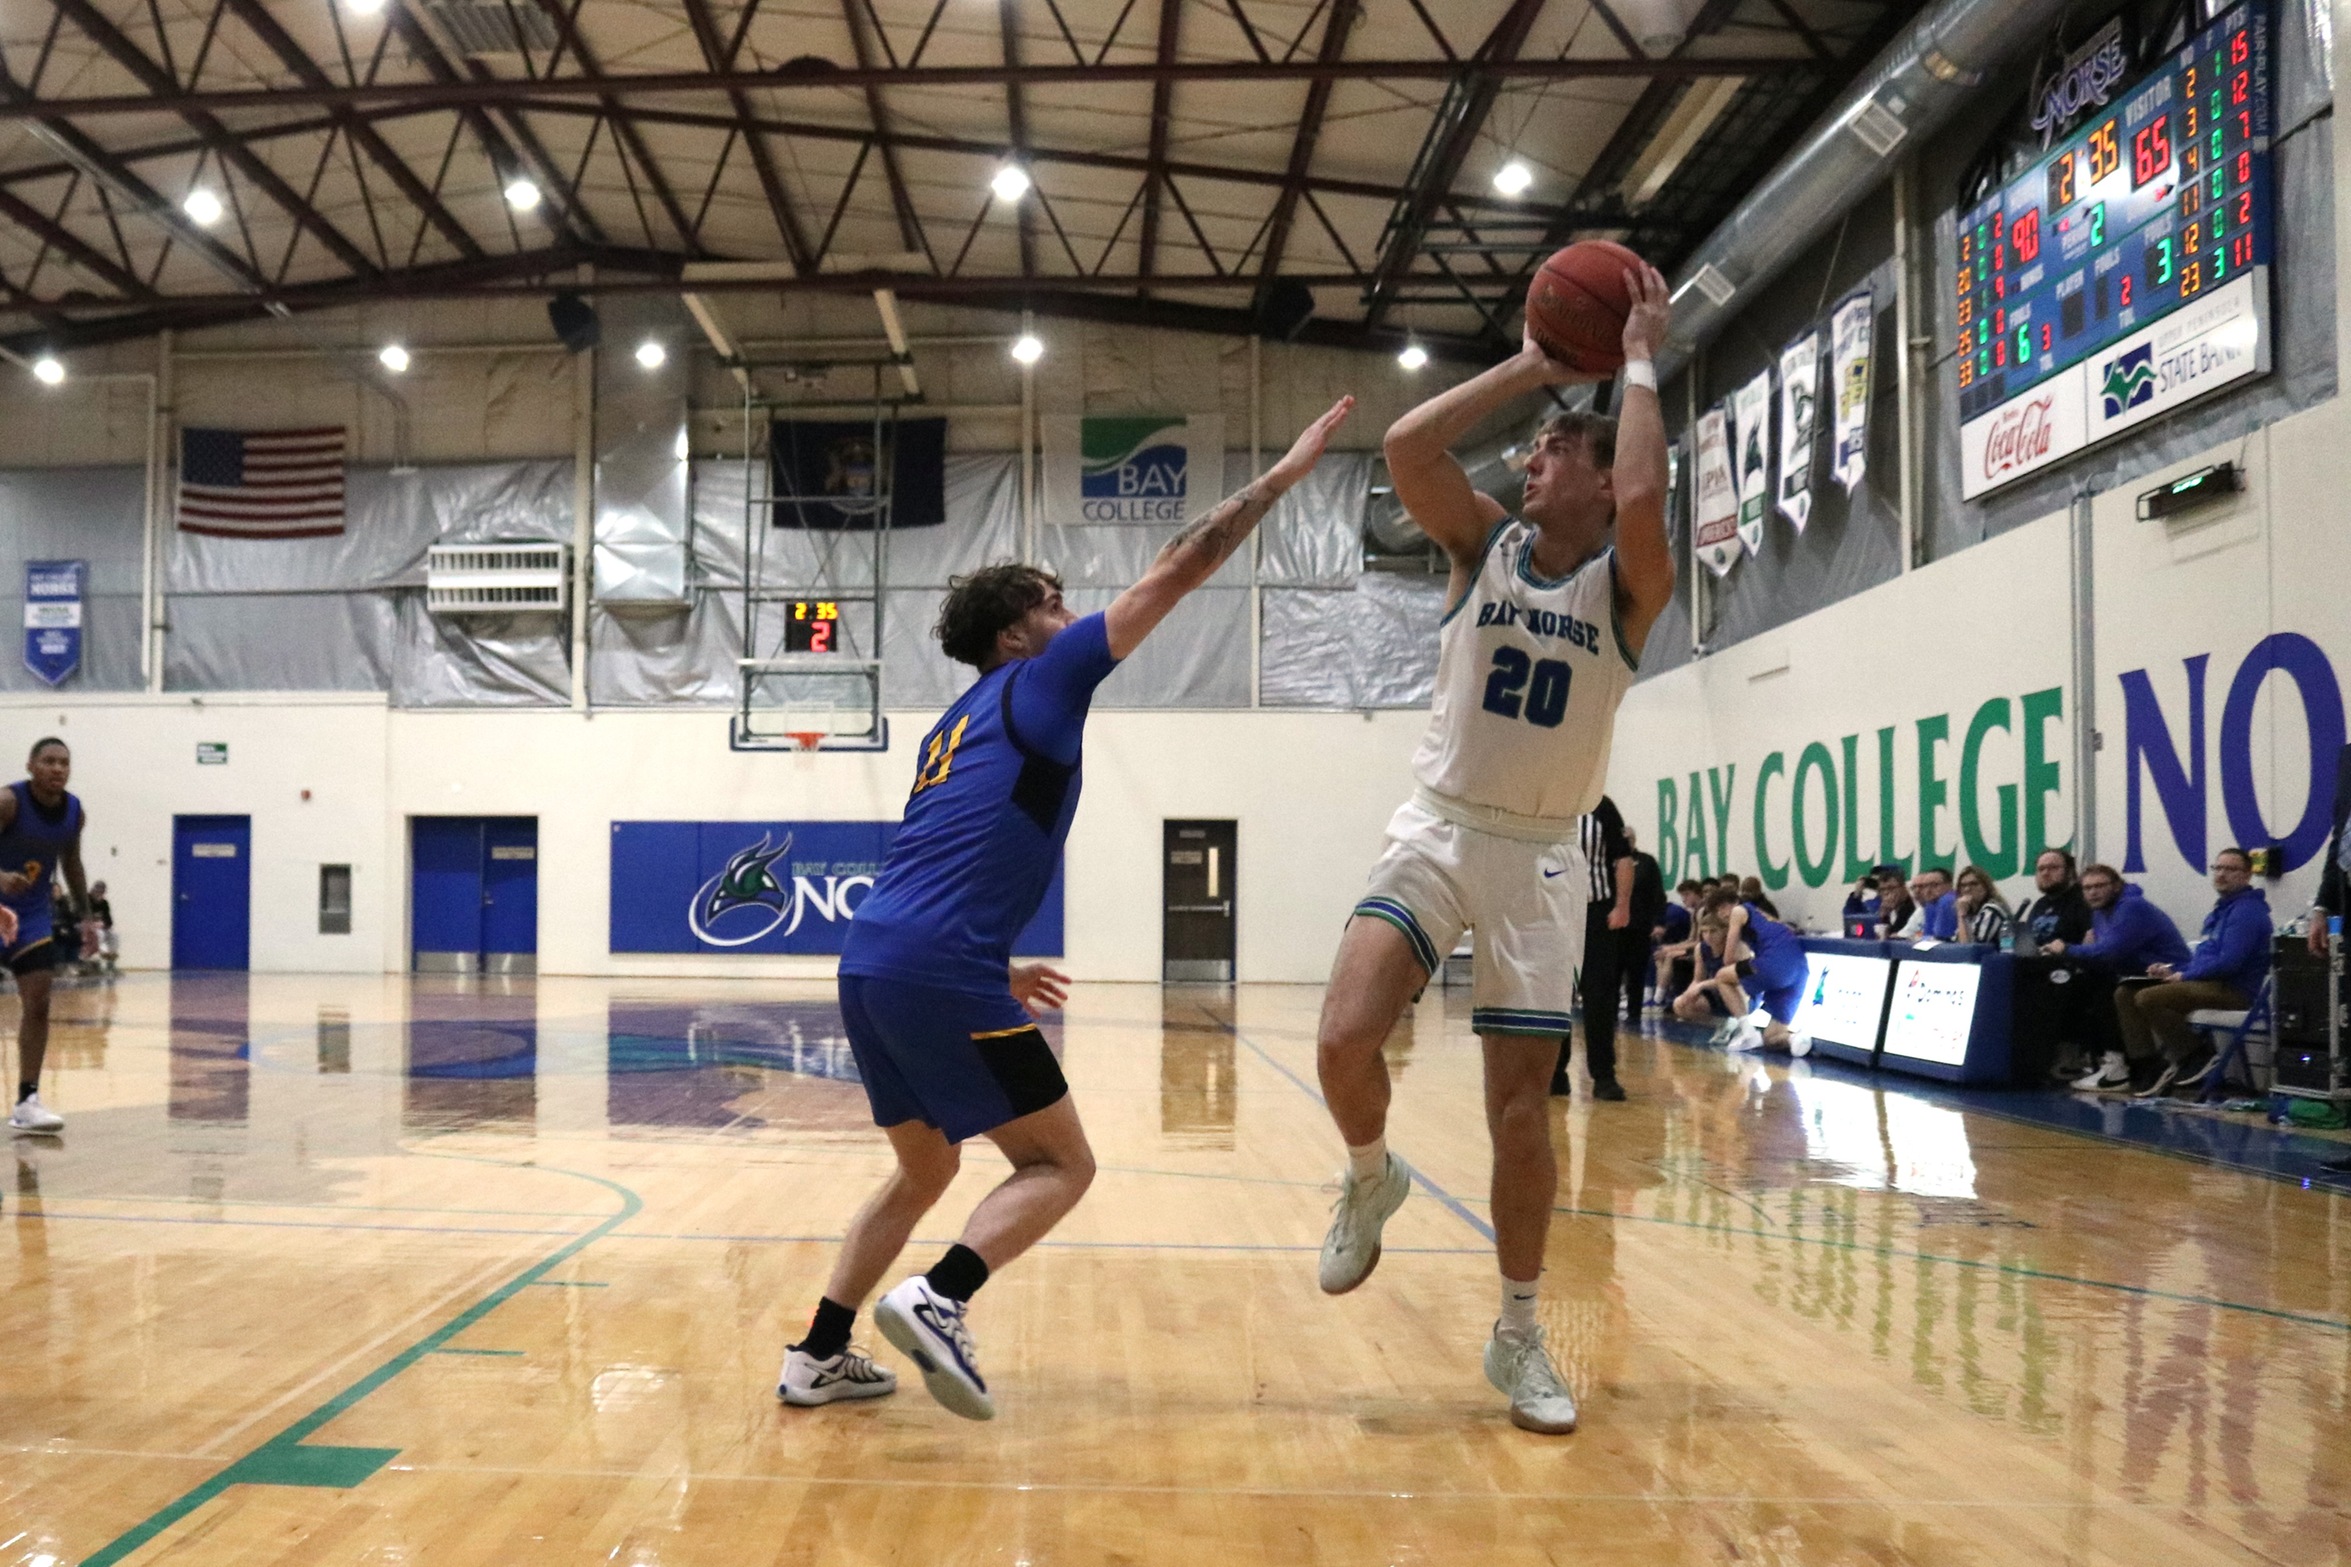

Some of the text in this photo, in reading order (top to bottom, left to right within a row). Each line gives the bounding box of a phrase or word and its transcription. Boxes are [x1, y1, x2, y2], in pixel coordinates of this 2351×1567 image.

[2031, 32, 2126, 150] NORSE
[2185, 29, 2249, 98] 2 1 15
[2125, 73, 2172, 126] VISITOR
[2186, 69, 2249, 137] 3 0 12
[2059, 116, 2120, 206] 2:35
[2135, 114, 2171, 187] 65
[2187, 110, 2250, 173] 4 0 7
[2183, 181, 2199, 217] 11
[2211, 167, 2224, 199] 0
[2237, 152, 2251, 184] 0
[1993, 211, 2003, 239] 2
[2012, 206, 2040, 266] 90
[2090, 199, 2105, 248] 2
[2183, 193, 2252, 256] 12 0 2
[2157, 237, 2172, 286] 3
[2180, 232, 2252, 299] 23 3 11
[2121, 275, 2131, 308] 2
[2017, 323, 2030, 364] 6
[2041, 323, 2051, 351] 3
[2160, 349, 2197, 393] STATE
[1118, 463, 1187, 495] BAY
[1083, 500, 1186, 521] COLLEGE
[810, 621, 831, 653] 2
[1476, 600, 1600, 656] BAY NORSE
[1482, 645, 1573, 729] 20
[1657, 686, 2073, 892] BAY COLLEGE
[791, 861, 888, 877] BAY COLL
